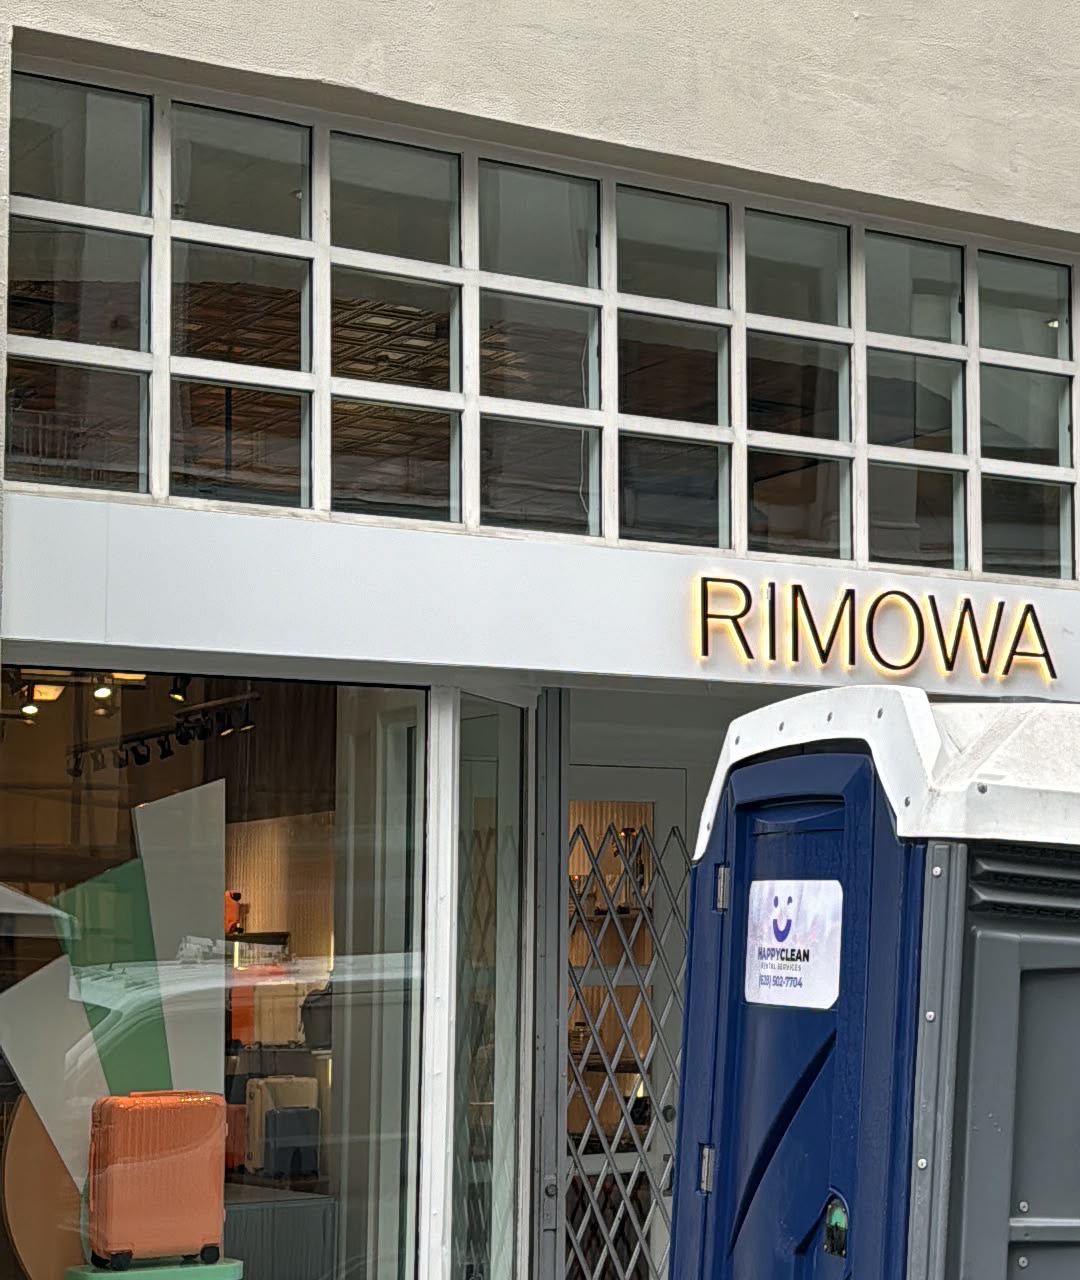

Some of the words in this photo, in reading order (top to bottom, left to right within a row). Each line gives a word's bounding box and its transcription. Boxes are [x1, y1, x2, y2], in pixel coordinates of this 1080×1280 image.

[699, 575, 1059, 681] RIMOWA
[757, 946, 810, 963] HAPPYCLEAN
[772, 975, 803, 989] 502-7704
